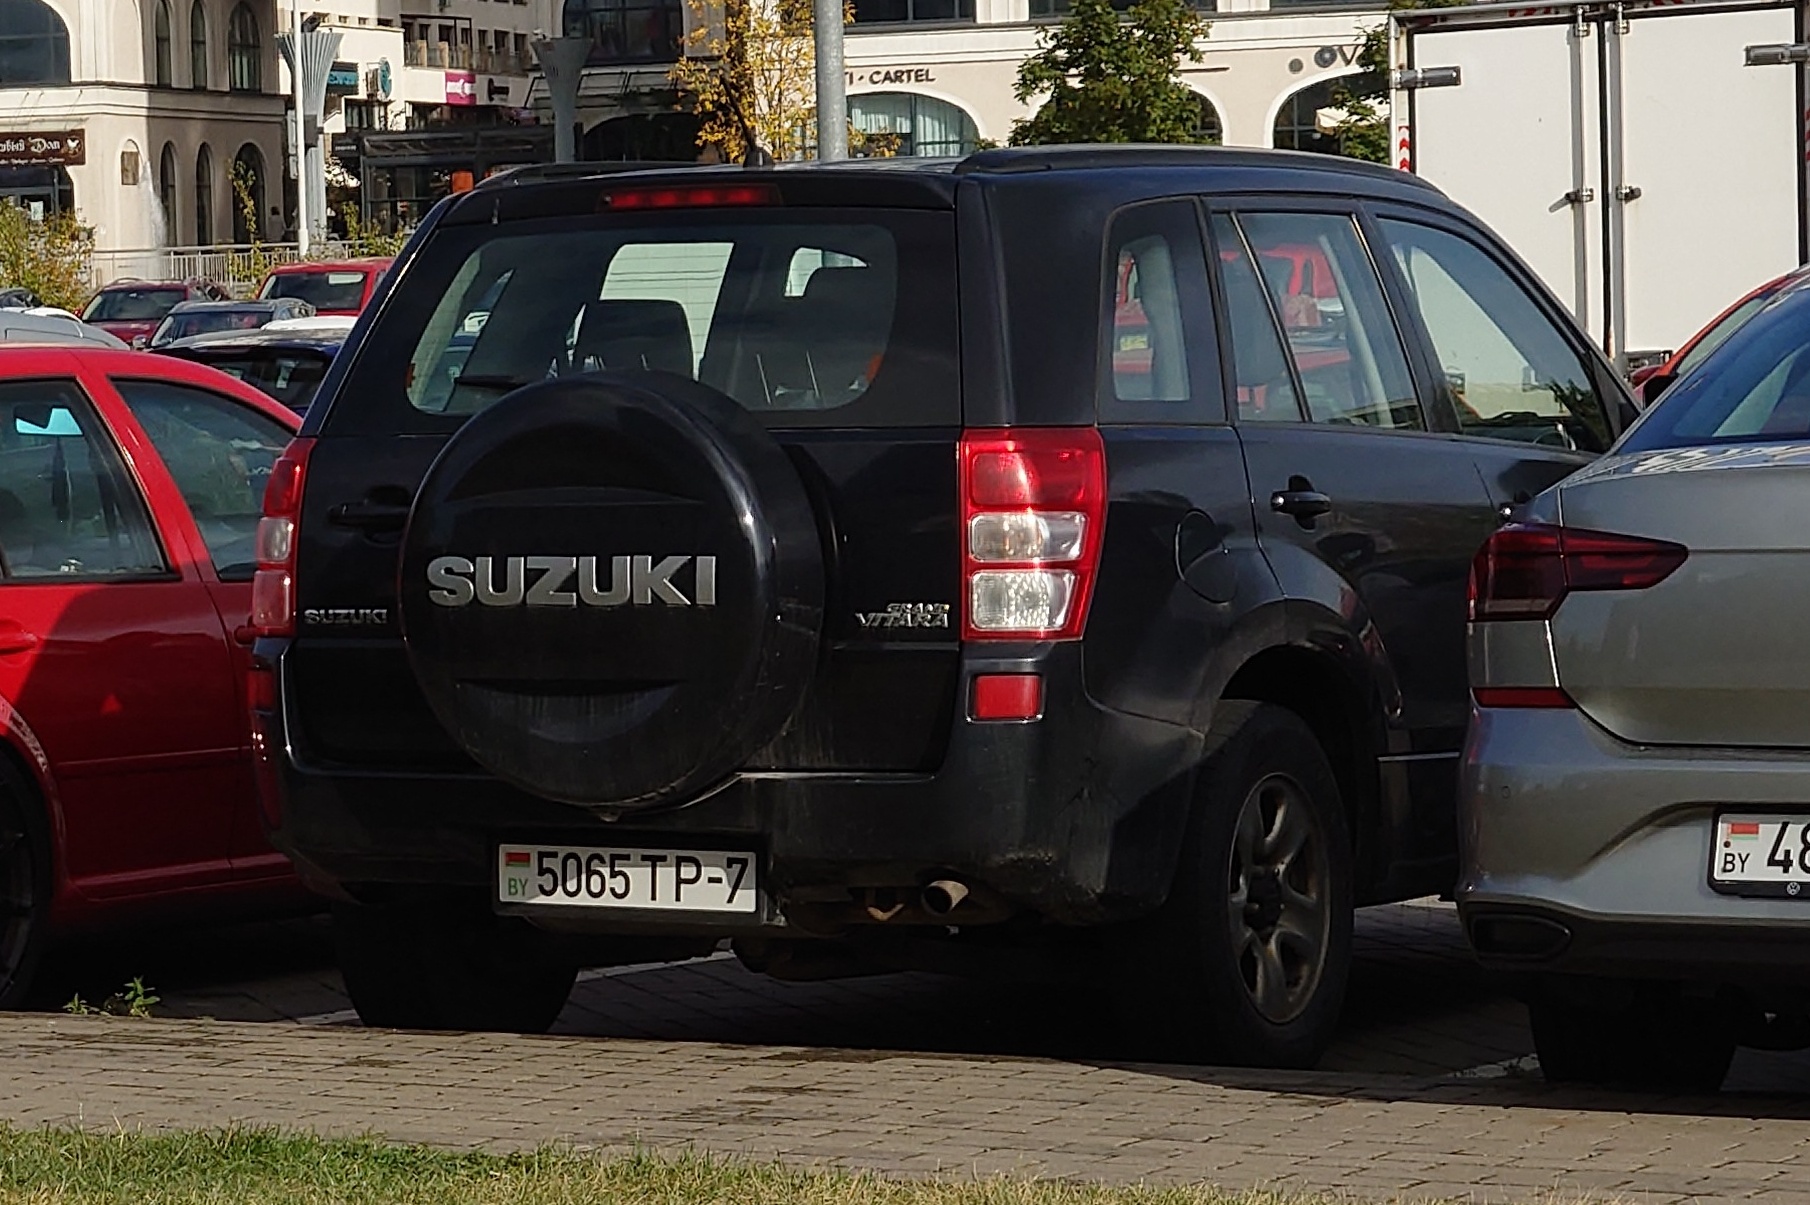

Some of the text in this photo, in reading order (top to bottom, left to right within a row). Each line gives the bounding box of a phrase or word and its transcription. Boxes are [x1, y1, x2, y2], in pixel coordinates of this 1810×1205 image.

[868, 68, 937, 85] CARTEL
[426, 555, 717, 607] SUZUKI
[304, 609, 388, 625] SUZUKI
[855, 612, 949, 628] VITARA
[1722, 852, 1750, 873] BY
[537, 851, 749, 903] 5065 TP-7
[508, 878, 528, 896] BY
